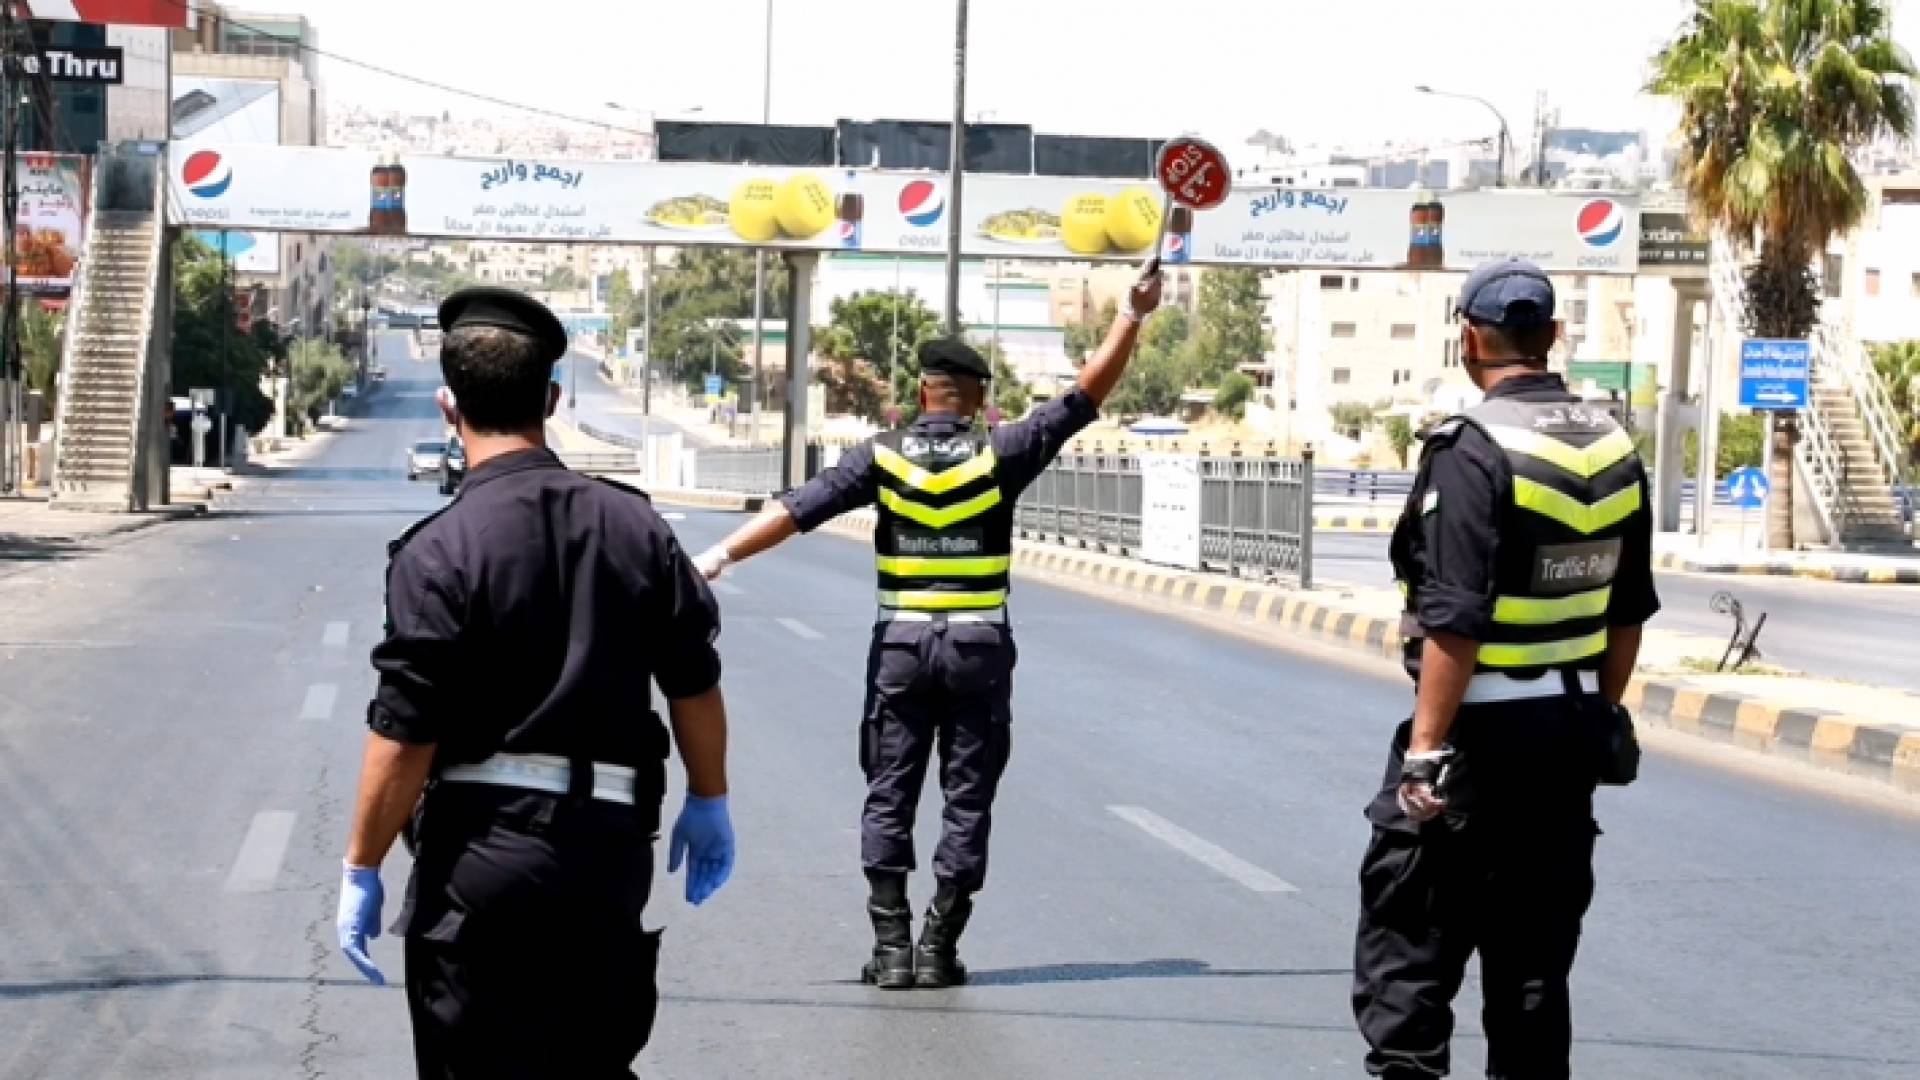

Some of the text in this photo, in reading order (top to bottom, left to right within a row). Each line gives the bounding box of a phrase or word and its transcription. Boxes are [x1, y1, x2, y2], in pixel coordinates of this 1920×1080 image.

[46, 51, 116, 78] Thru
[897, 534, 979, 552] Traffic Police
[1542, 556, 1586, 579] Traffic
